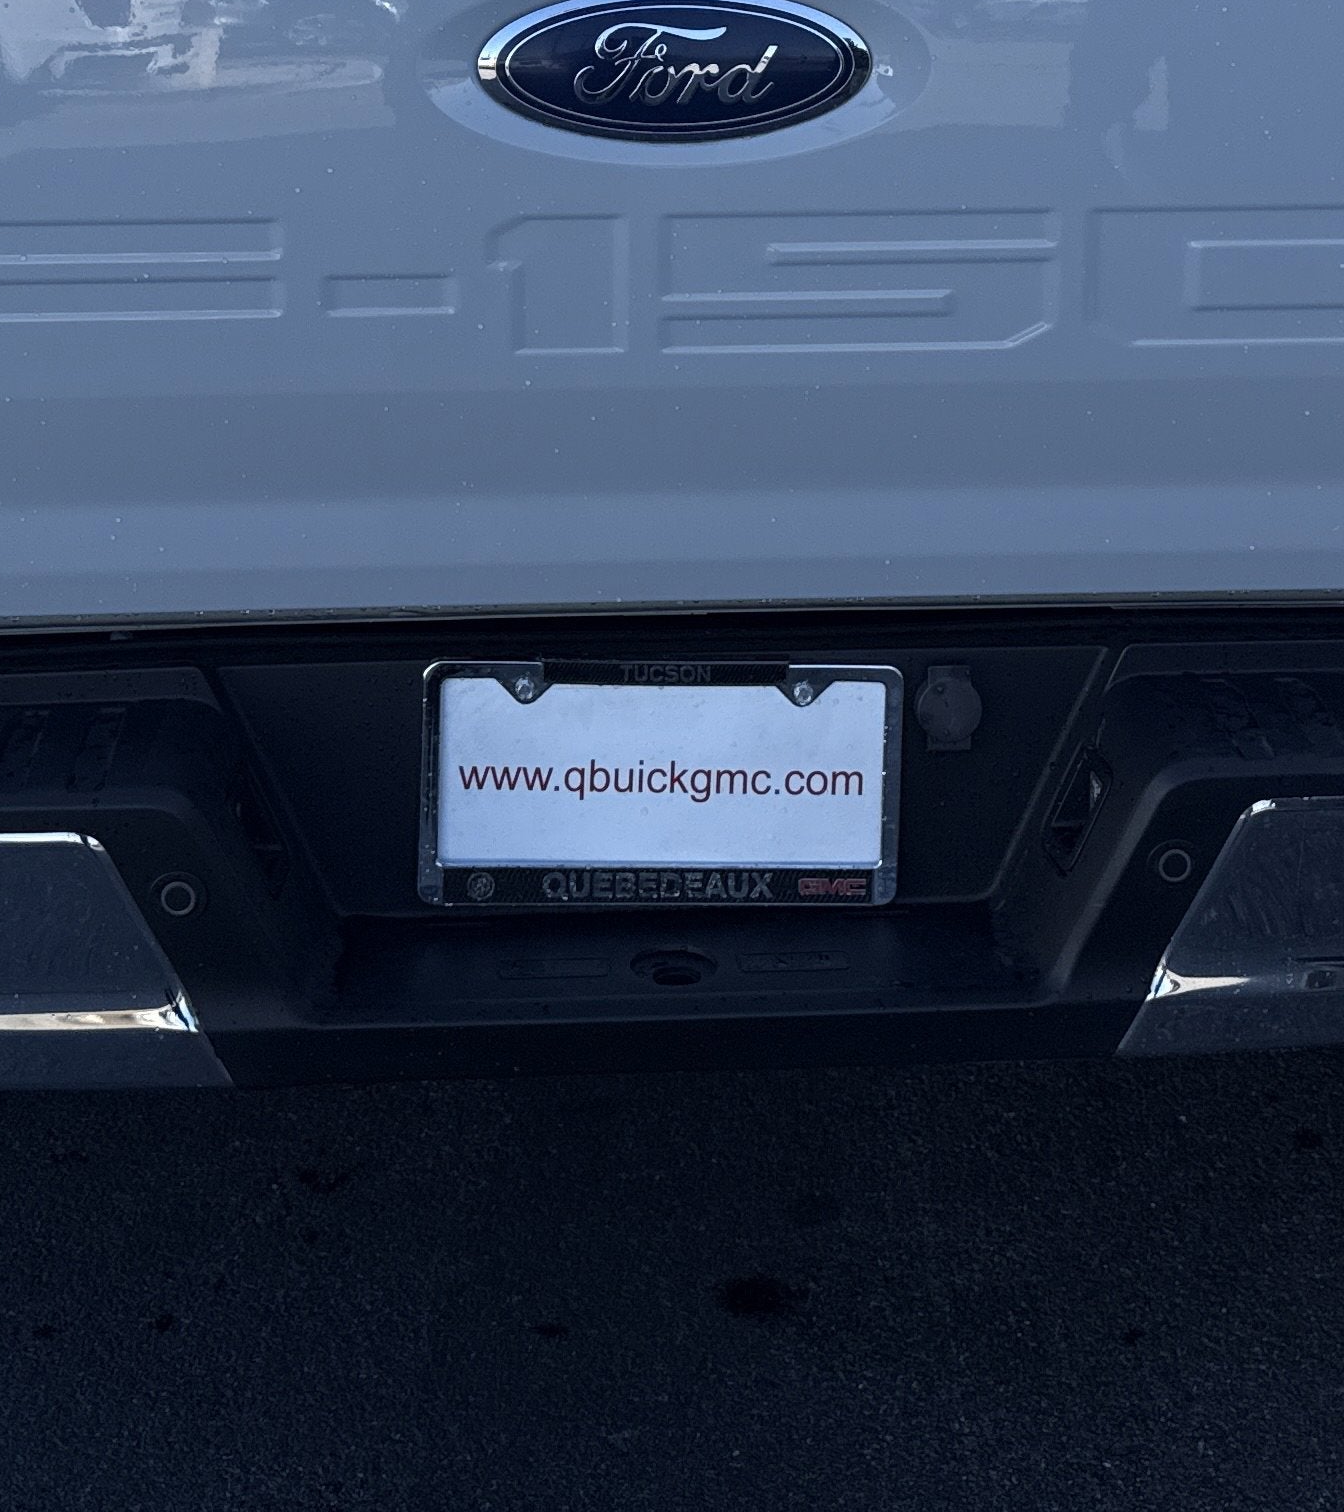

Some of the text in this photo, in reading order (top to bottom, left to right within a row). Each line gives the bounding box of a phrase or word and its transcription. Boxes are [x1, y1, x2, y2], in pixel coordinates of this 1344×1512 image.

[572, 22, 779, 105] Ford
[620, 663, 712, 684] TUCSON
[458, 759, 865, 803] www.qbuickgmc.com
[541, 871, 868, 900] QUEBEDEAUX GMC
